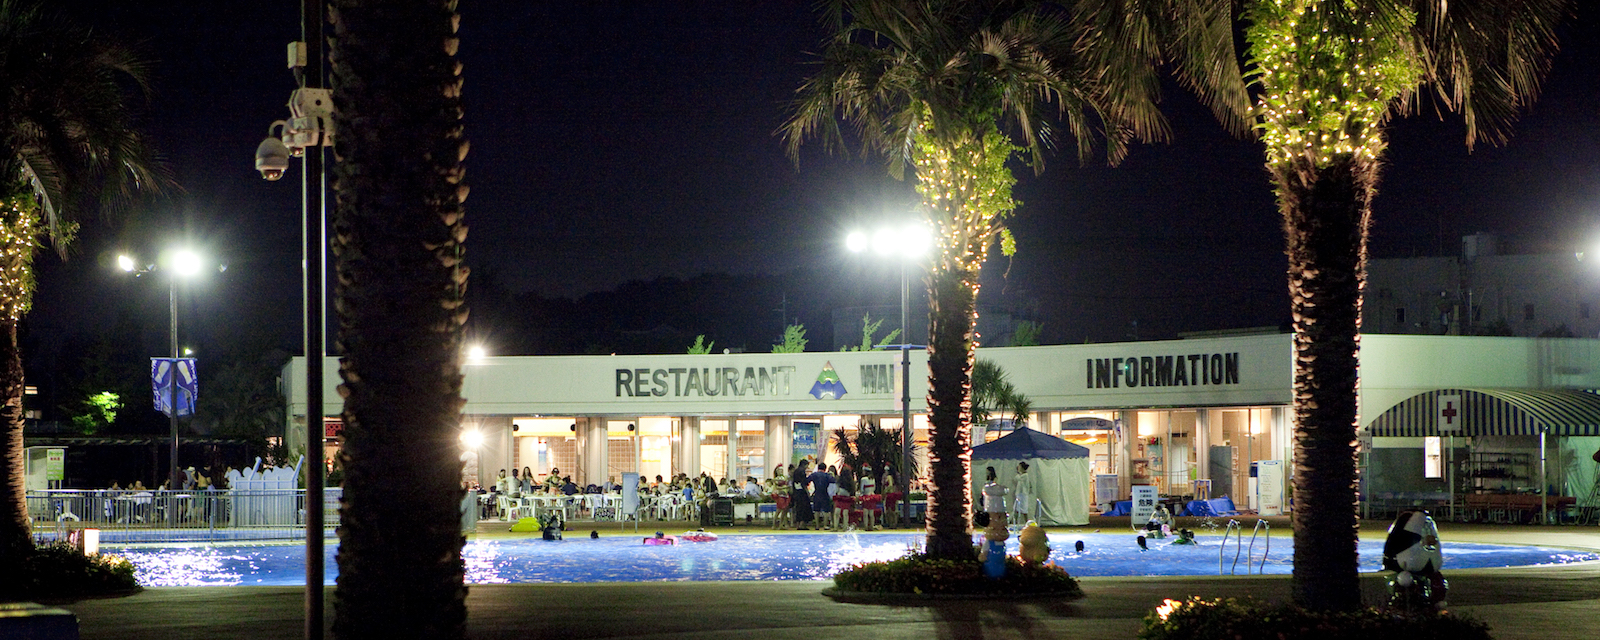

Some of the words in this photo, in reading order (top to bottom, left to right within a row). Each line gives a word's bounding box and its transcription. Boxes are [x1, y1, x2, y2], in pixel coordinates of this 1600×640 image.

[615, 365, 797, 397] RESTAURANT
[1086, 352, 1239, 389] INFORMATION
[1138, 498, 1154, 507] 危険
